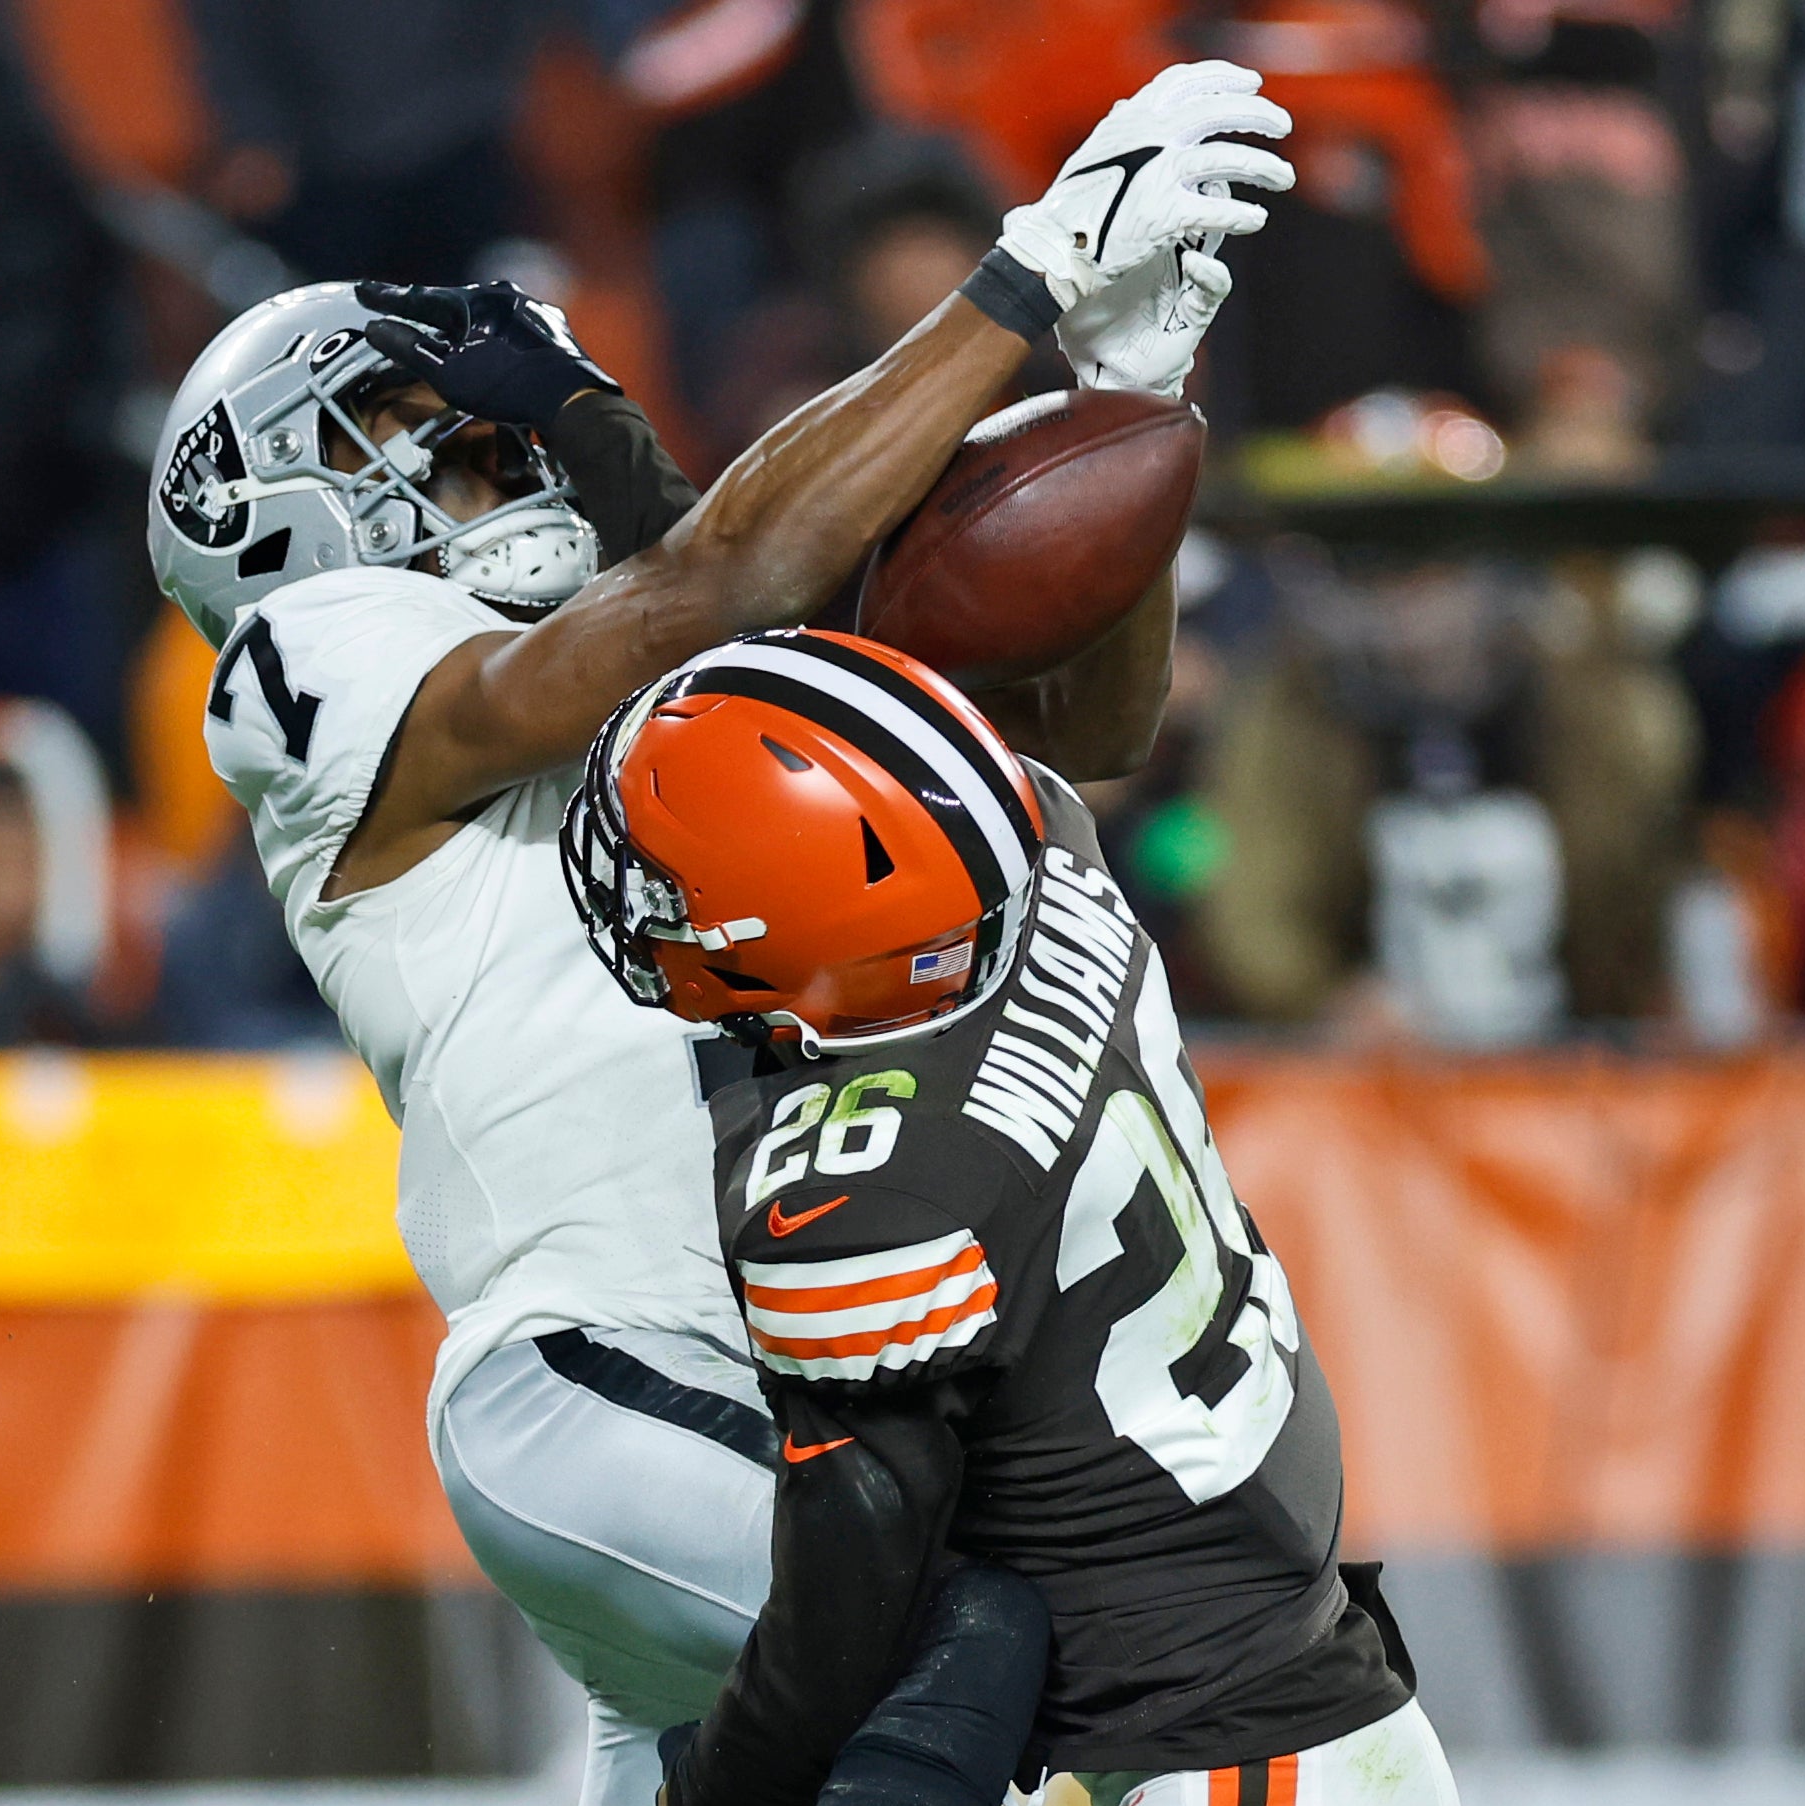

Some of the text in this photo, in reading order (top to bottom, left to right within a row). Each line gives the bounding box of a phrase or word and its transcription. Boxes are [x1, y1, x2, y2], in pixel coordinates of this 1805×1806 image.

[163, 409, 219, 498] RAIDERS
[207, 607, 328, 769] 7
[961, 845, 1138, 1173] WILLIAMS
[745, 1068, 918, 1212] 26
